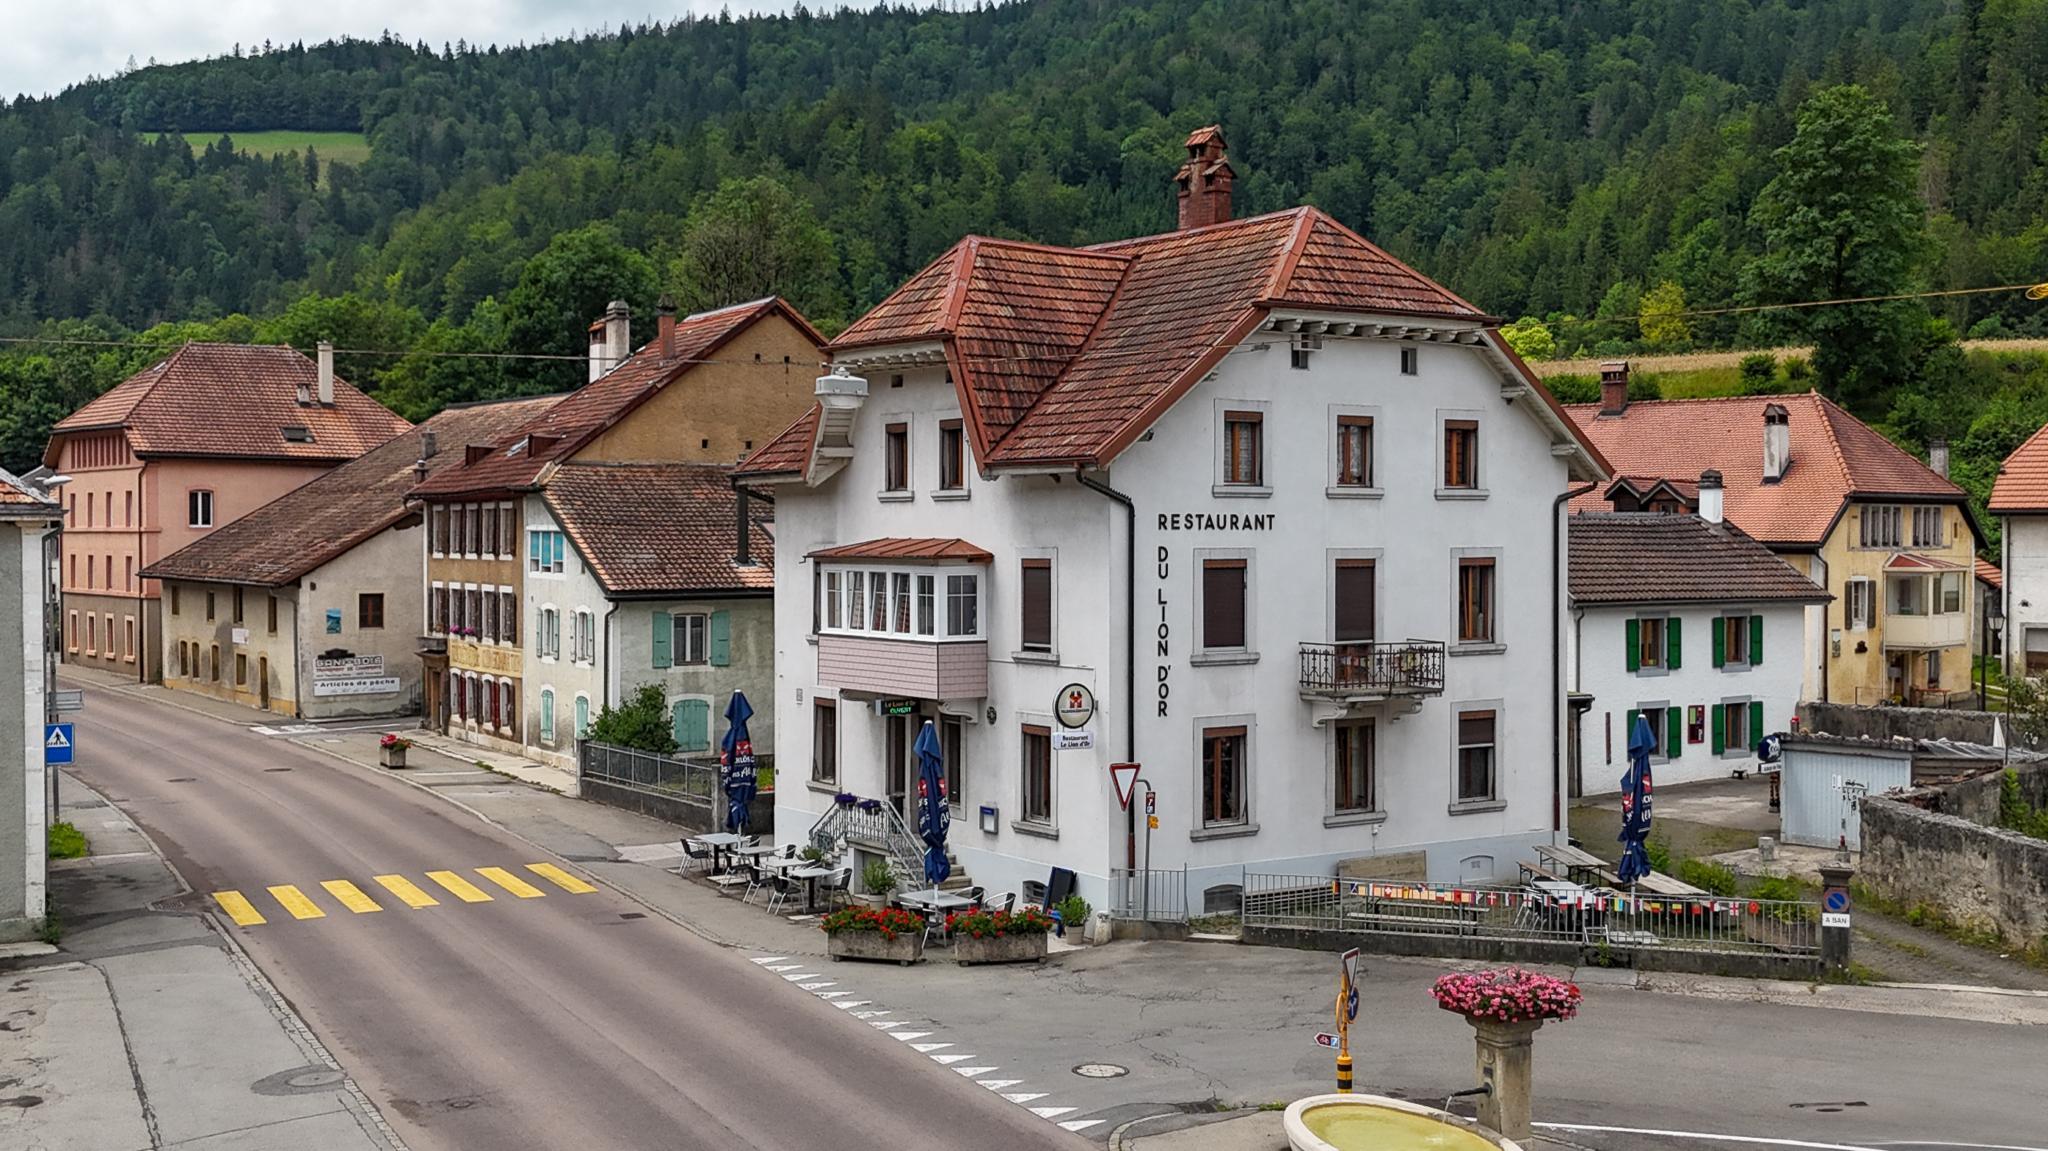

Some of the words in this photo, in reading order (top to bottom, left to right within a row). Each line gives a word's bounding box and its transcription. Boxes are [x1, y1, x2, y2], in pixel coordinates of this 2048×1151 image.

[1157, 513, 1276, 531] RESTAURANT
[1157, 546, 1169, 579] DU
[1157, 588, 1169, 657] LION
[1157, 665, 1171, 717] D'OR
